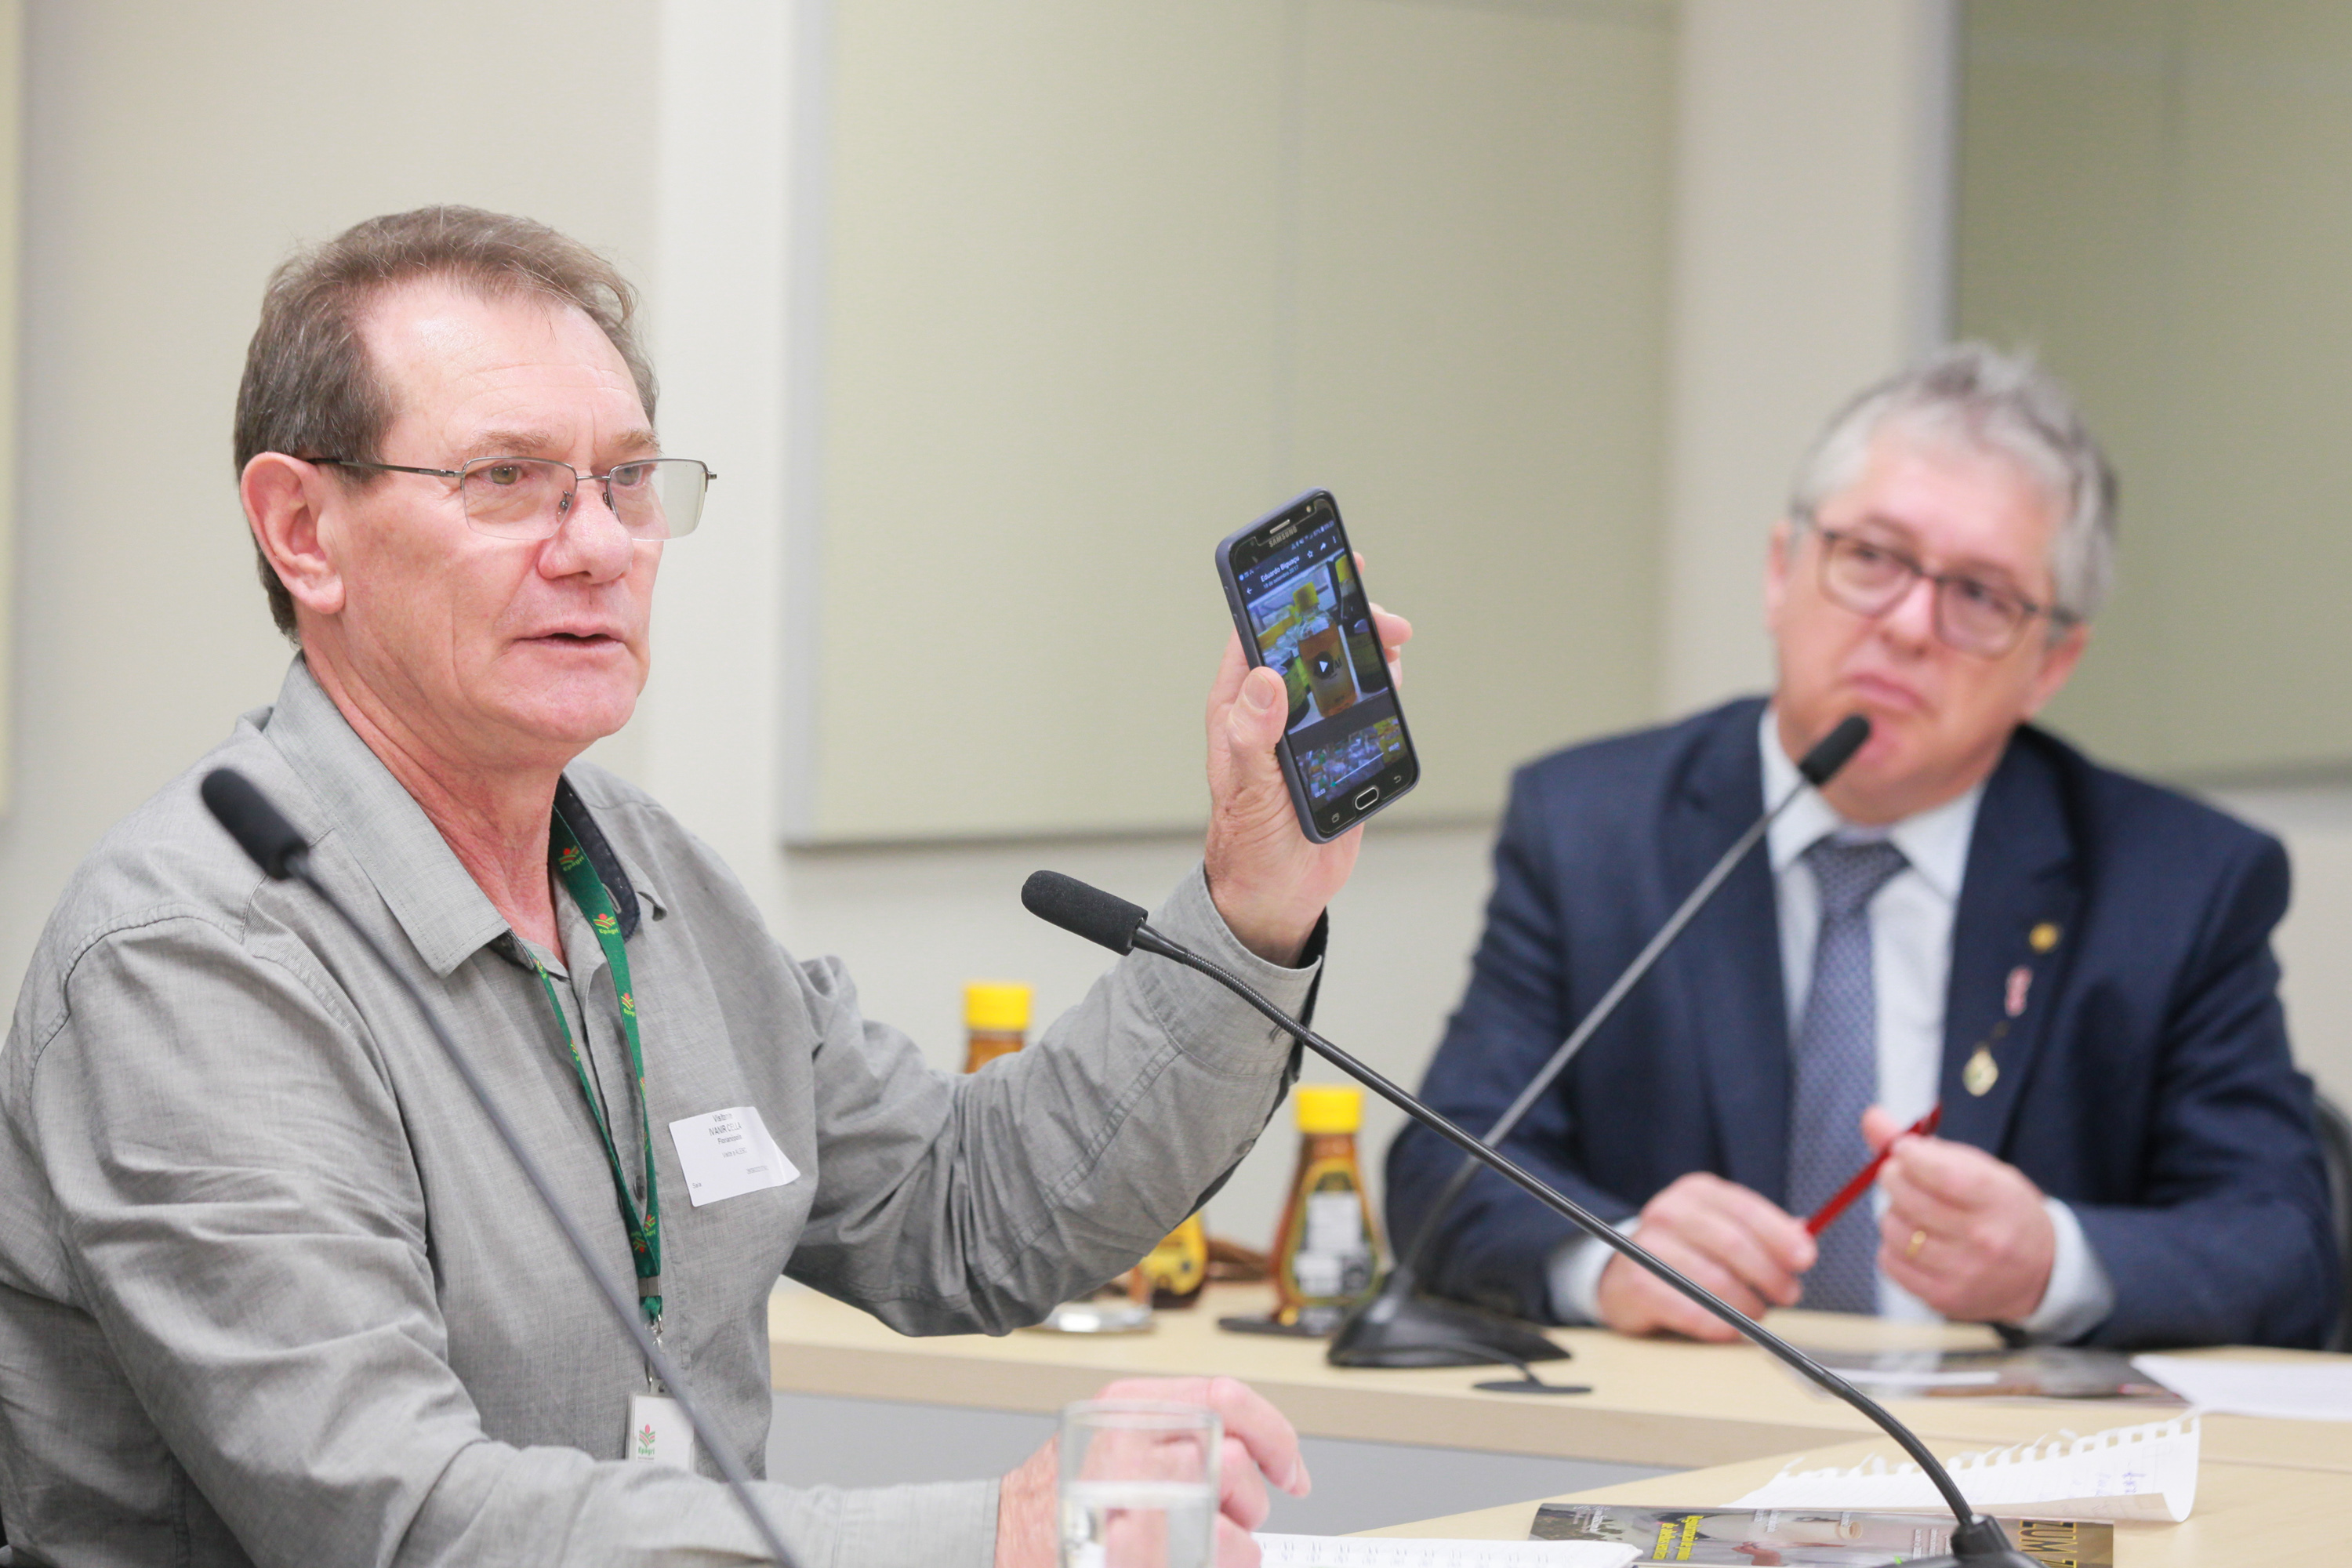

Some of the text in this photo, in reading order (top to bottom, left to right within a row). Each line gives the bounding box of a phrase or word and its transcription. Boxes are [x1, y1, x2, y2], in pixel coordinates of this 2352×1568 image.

[1269, 525, 1298, 547] SAMSUNG
[1260, 555, 1300, 583] Eduardo Biguaçu
[563, 855, 585, 872] Epagri
[726, 1121, 742, 1132] CELLA
[638, 1446, 655, 1457] Epagri
[2019, 1520, 2078, 1553] ZUM
